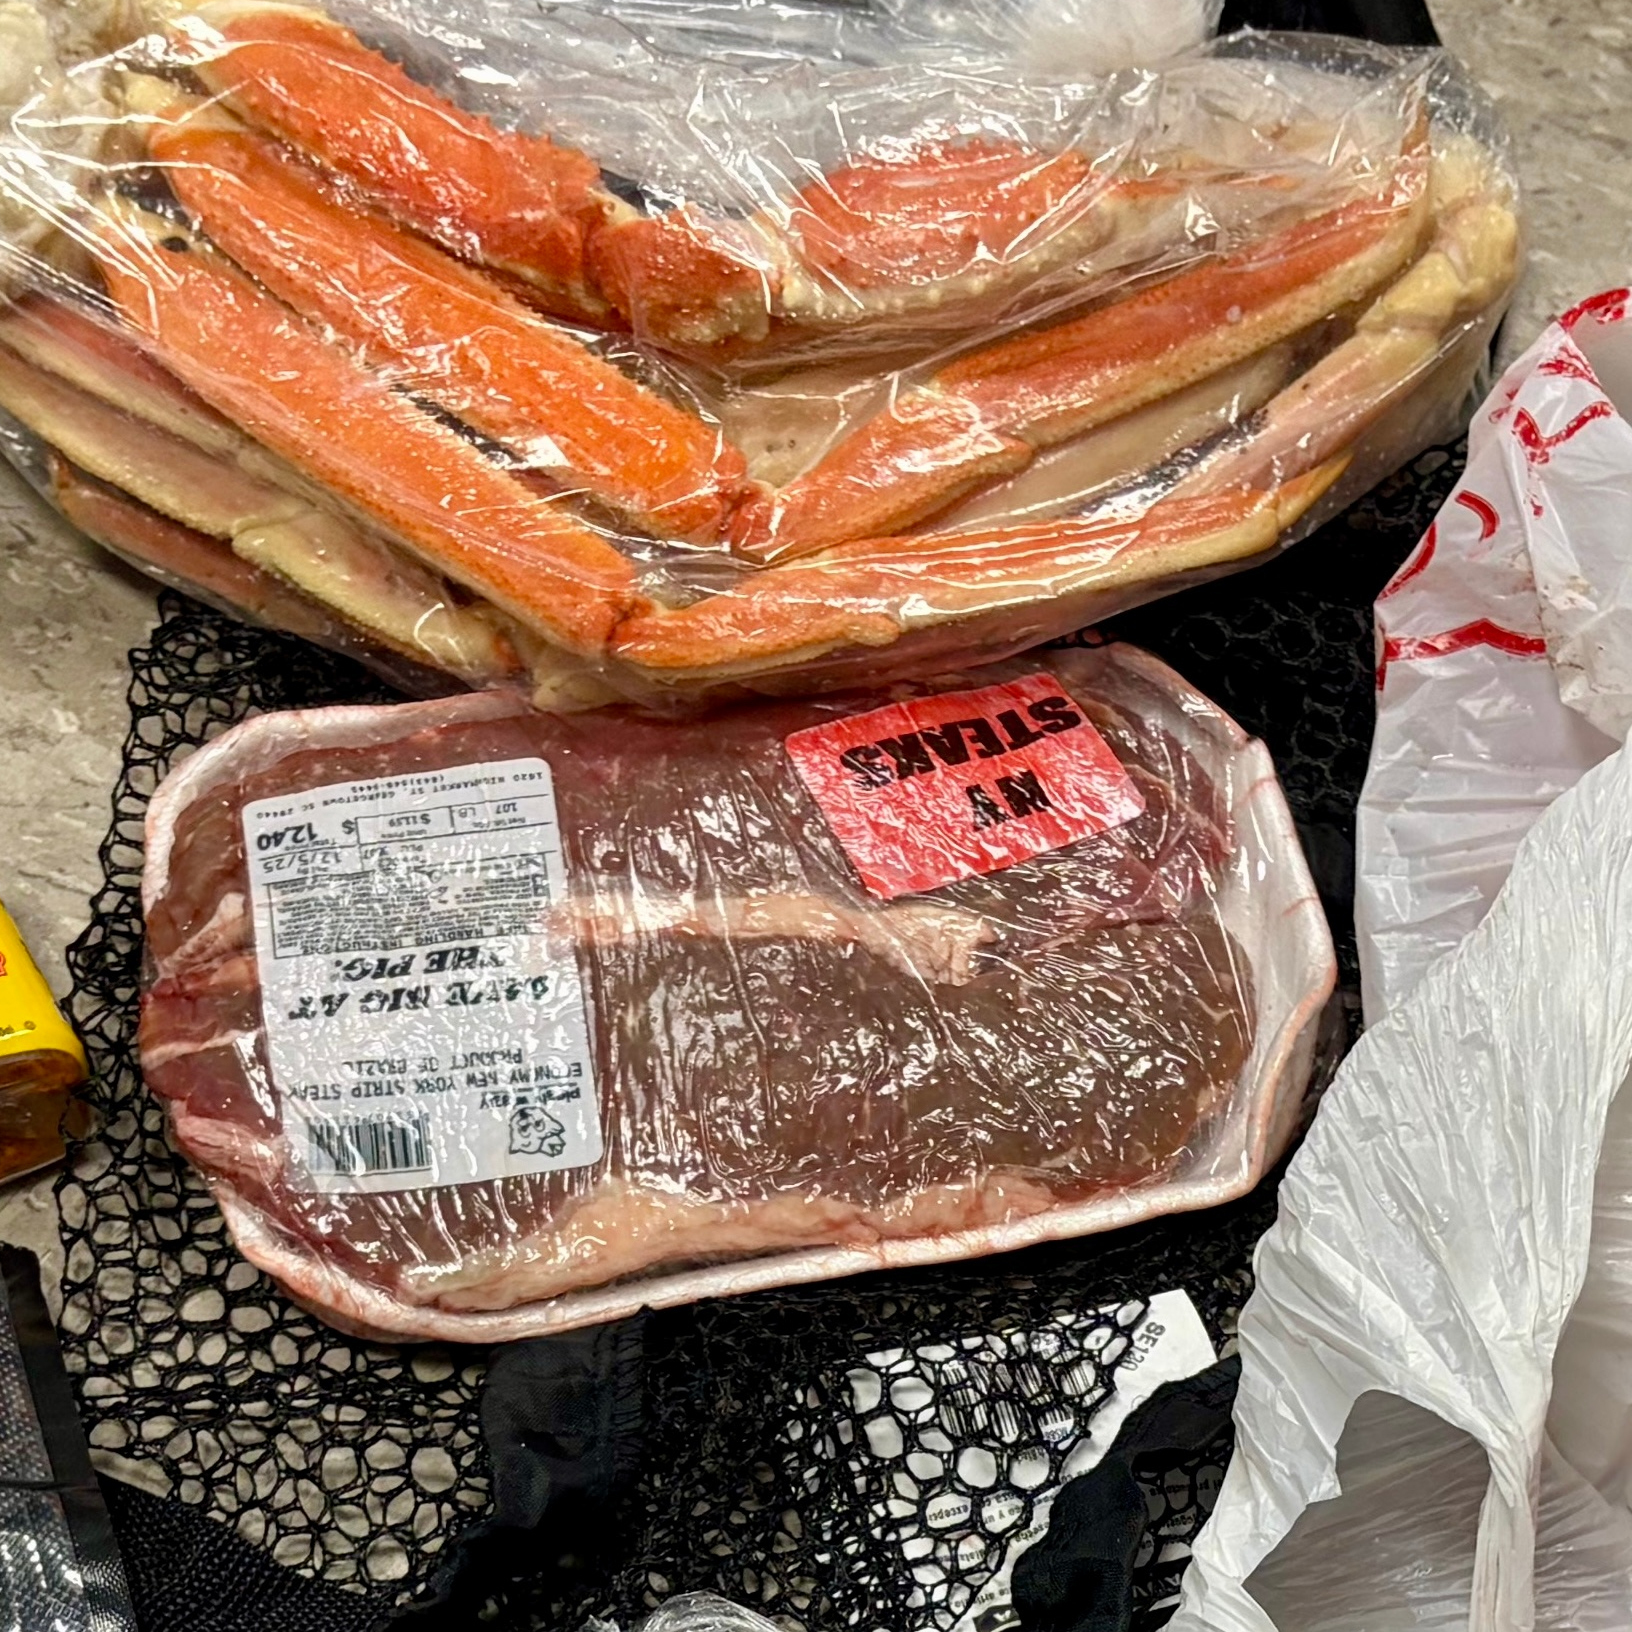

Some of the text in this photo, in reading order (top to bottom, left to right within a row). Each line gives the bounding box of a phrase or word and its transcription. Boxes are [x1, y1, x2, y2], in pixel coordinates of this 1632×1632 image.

[840, 696, 1082, 792] STEAKS
[965, 768, 1054, 832] NY
[255, 822, 316, 852] 12.40
[260, 849, 341, 874] 12/5/25
[414, 928, 483, 944] HANDLING
[423, 942, 504, 974] THE
[285, 992, 350, 1021] AT
[357, 984, 431, 1015] BIG
[415, 1056, 439, 1072] OF
[350, 1077, 405, 1099] STRIP
[413, 1075, 456, 1093] YORK
[465, 1071, 498, 1088] NEW
